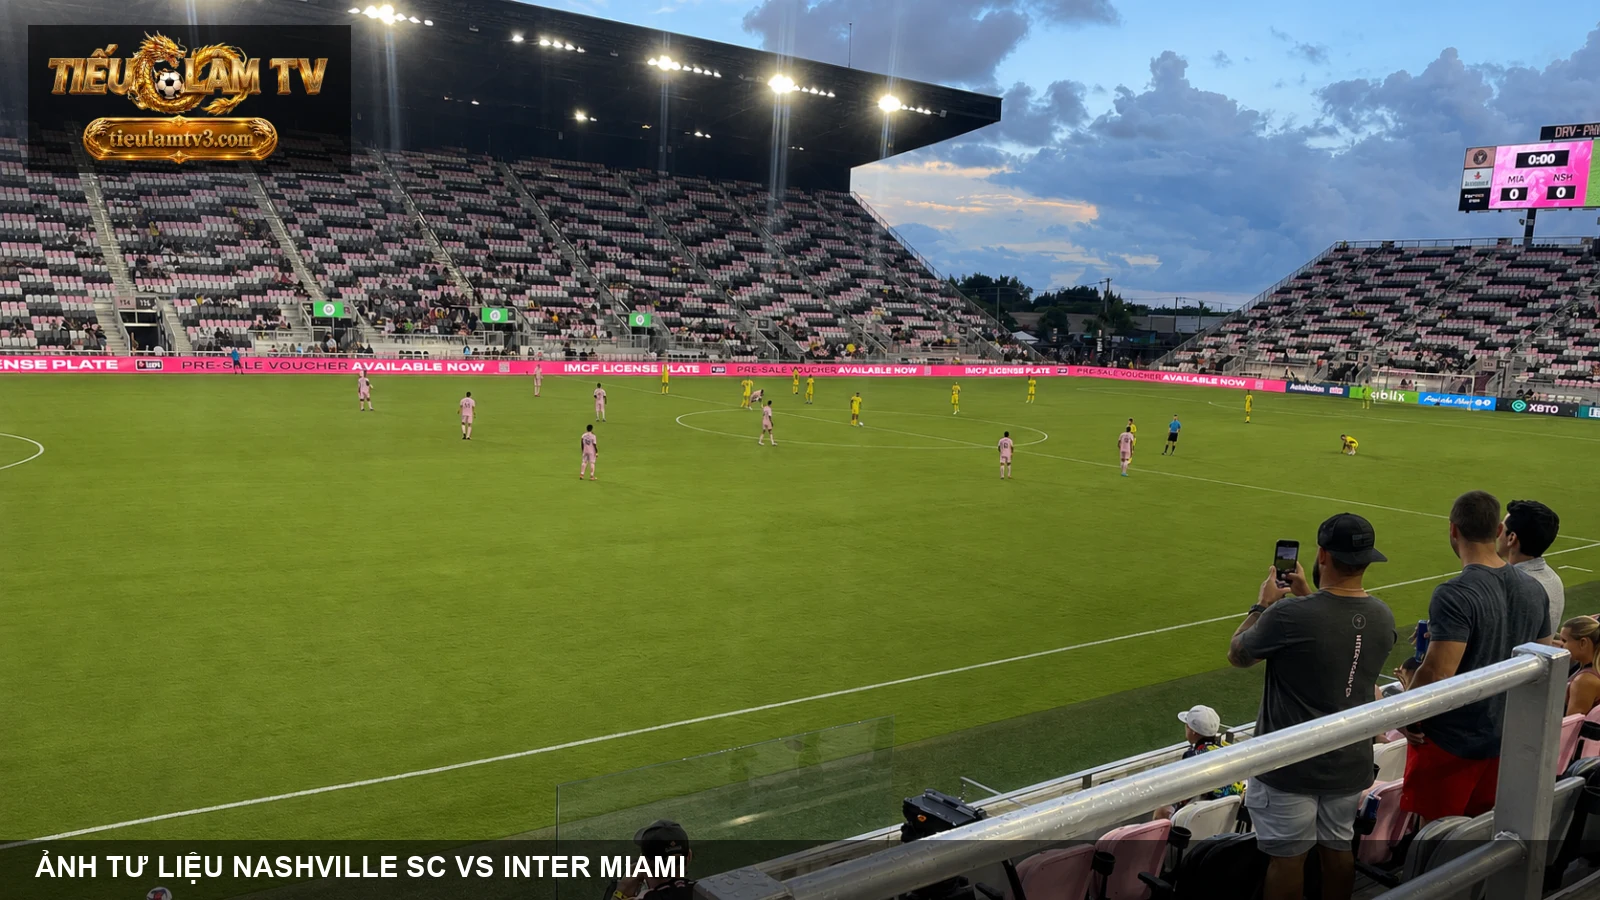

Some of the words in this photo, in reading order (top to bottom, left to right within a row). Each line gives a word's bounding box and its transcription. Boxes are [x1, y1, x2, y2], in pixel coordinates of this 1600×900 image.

[1528, 153, 1555, 165] 0:00
[1507, 175, 1525, 184] MIA
[1553, 173, 1573, 182] NSH
[1509, 188, 1519, 200] 0
[1556, 187, 1566, 198] 0
[0, 359, 48, 370] NSE
[52, 359, 118, 370] PLATE
[268, 361, 348, 370] VOUCHER
[352, 361, 442, 371] AVAILABLE
[447, 362, 485, 371] NOW
[564, 363, 599, 373] IMCF
[602, 364, 658, 373] LICENSE
[737, 366, 787, 374] PRE-SALE
[838, 366, 891, 374] AVAILABLE
[894, 366, 917, 374] NOW
[989, 367, 1023, 375] LICENSE
[1025, 367, 1051, 375] PLATE
[1121, 371, 1161, 380] VOUCHER
[1162, 374, 1218, 385] AVAILABLE
[1220, 378, 1246, 387] NOW
[1528, 403, 1559, 414] XBTO
